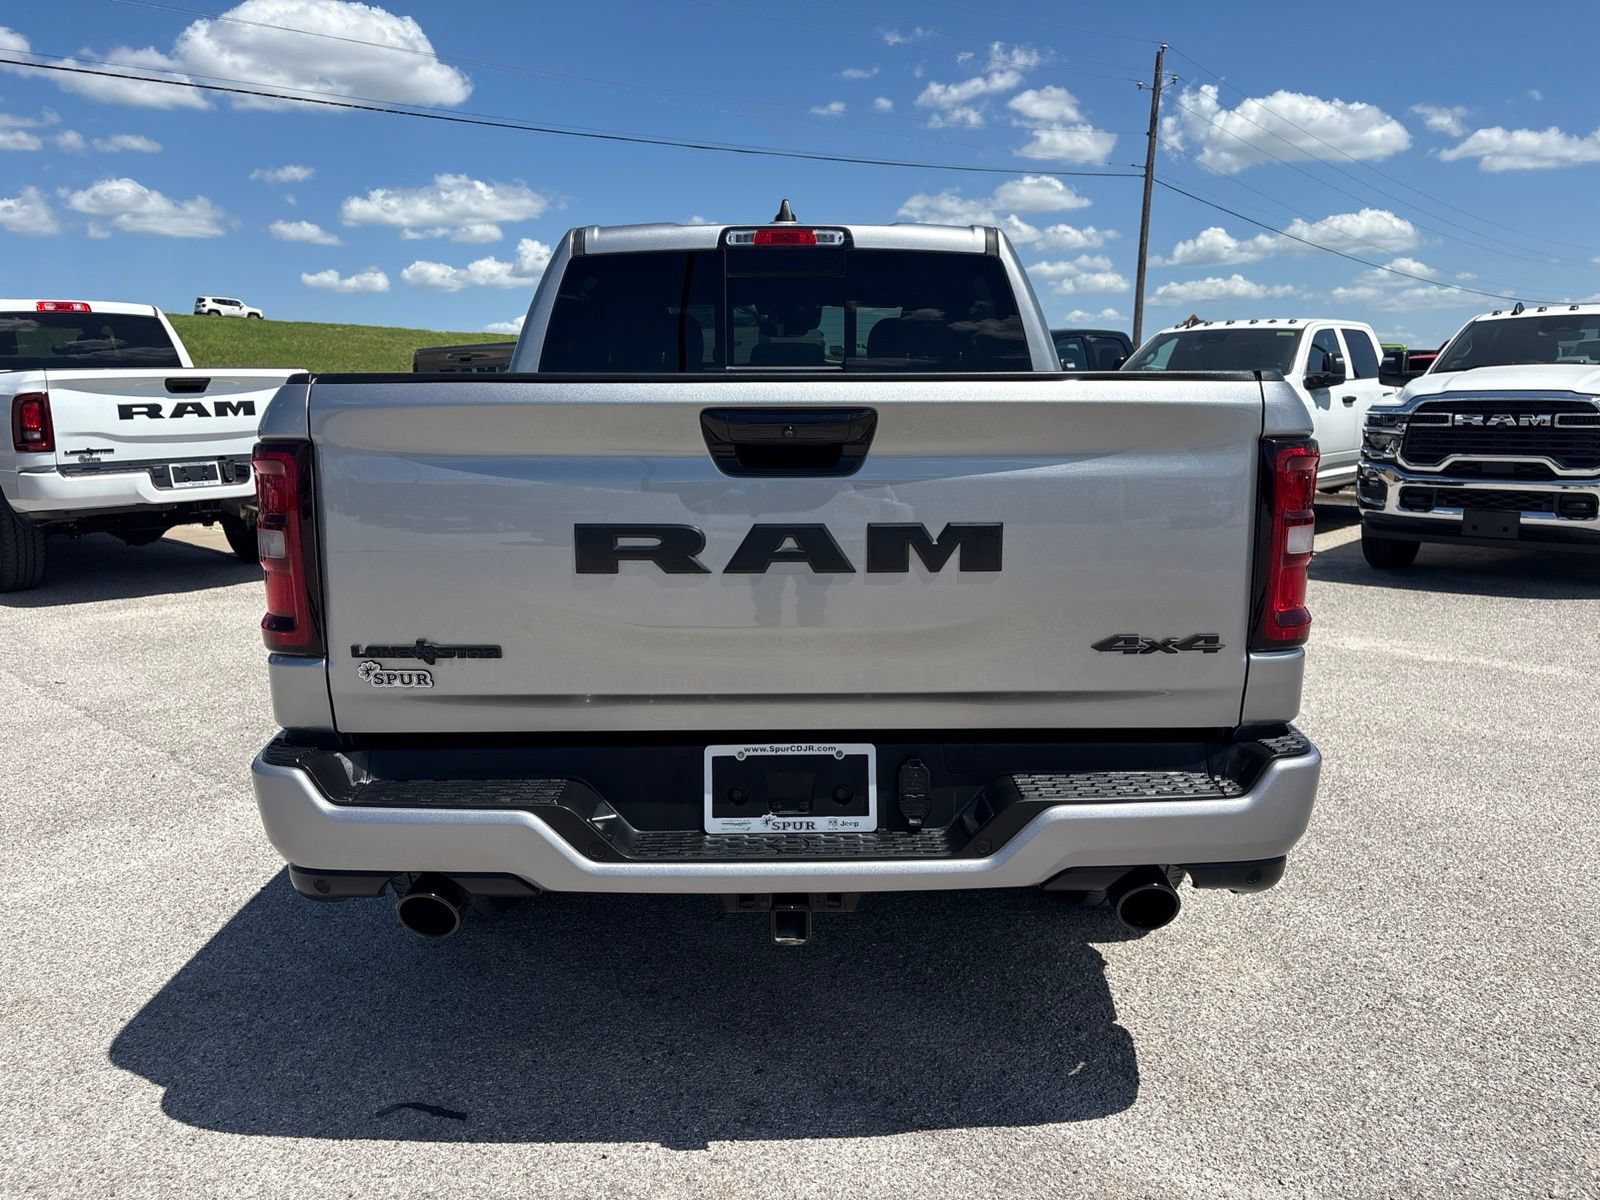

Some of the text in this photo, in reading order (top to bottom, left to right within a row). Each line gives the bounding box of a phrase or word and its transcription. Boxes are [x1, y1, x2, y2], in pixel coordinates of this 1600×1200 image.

[117, 401, 256, 420] RAM
[1455, 414, 1552, 427] RAM
[574, 522, 1004, 574] RAM
[1091, 633, 1226, 654] 4x4
[373, 672, 431, 685] SPUR
[744, 745, 837, 753] www.SpurCDJR.com
[772, 821, 816, 830] SPUR
[840, 820, 859, 828] Jeep
